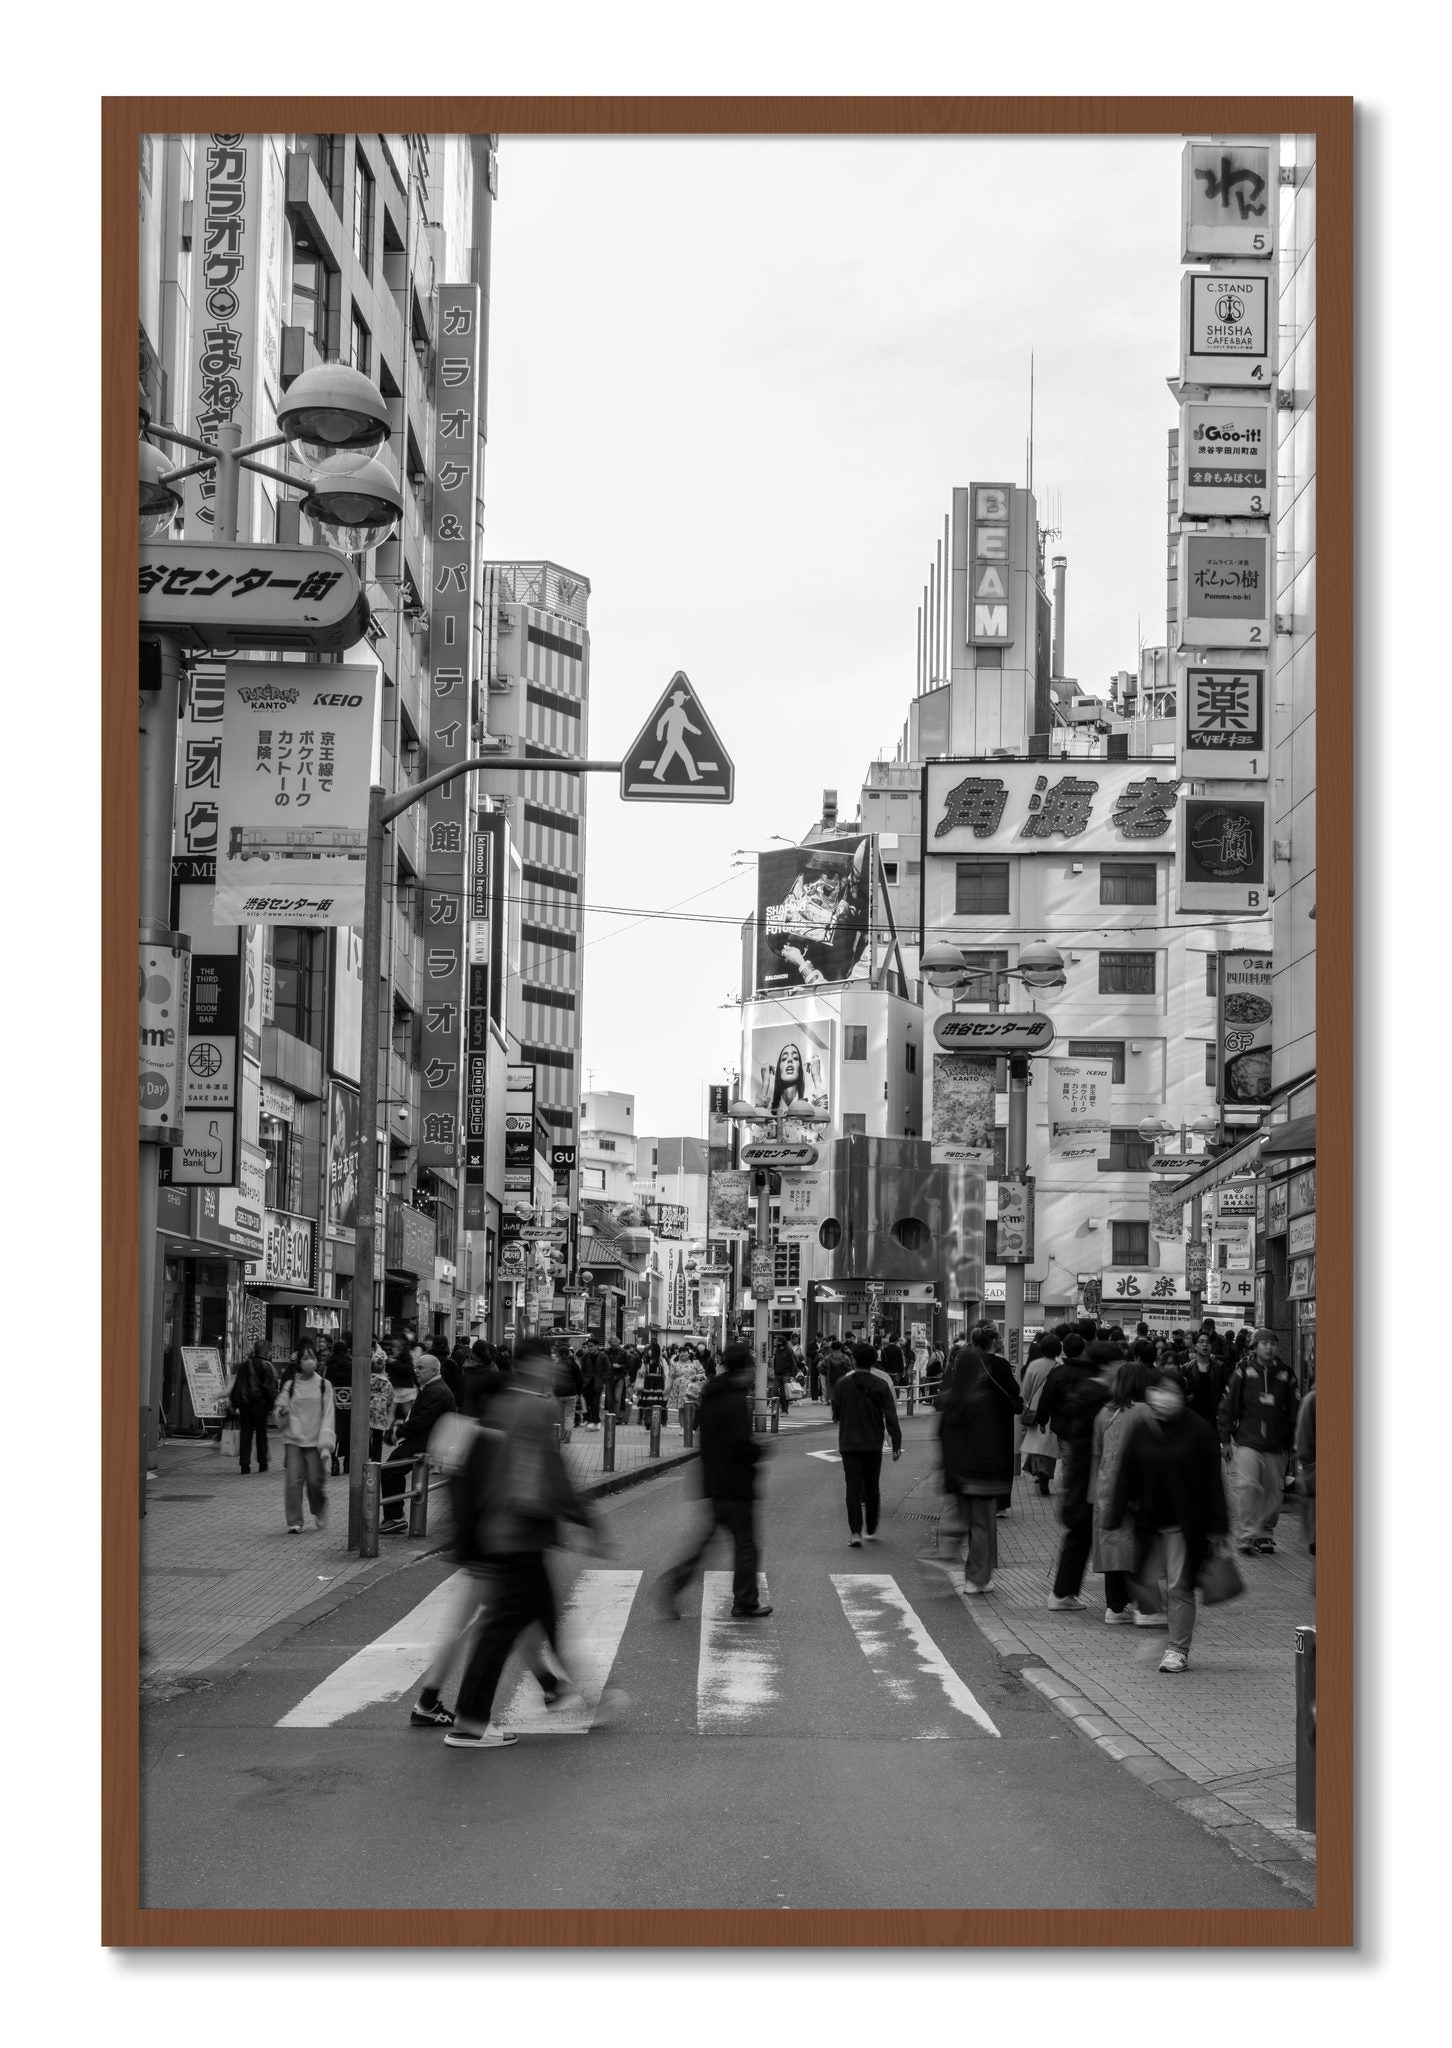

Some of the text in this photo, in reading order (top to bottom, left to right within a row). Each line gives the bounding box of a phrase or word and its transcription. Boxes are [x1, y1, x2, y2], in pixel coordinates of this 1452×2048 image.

[204, 146, 248, 290] カラオケ
[1252, 233, 1265, 250] 5
[1206, 283, 1253, 293] C.STAND
[1206, 325, 1253, 336] SHISHA
[1206, 336, 1253, 345] CAFE&BAR
[1251, 364, 1264, 381] 4
[1205, 425, 1262, 442] Goo-it!
[1198, 446, 1258, 455] 渋谷宇田川町店
[1193, 472, 1263, 484] 全身もみほぐし
[1249, 495, 1263, 513] 3
[974, 487, 1009, 637] BEAM
[1193, 568, 1260, 589] ポムの樹
[1249, 626, 1262, 643] 2
[251, 702, 287, 710] KANTO
[313, 693, 363, 708] KEIO
[1197, 676, 1250, 729] 薬
[256, 730, 273, 774] 冒険へ
[274, 730, 294, 807] カントーの
[295, 730, 315, 807] ポケパーク
[318, 732, 336, 793] 京王線で
[1248, 758, 1258, 775] 1
[934, 775, 1180, 839] 角海老
[1191, 816, 1254, 865] 一蘭
[476, 836, 486, 914] kimono hearts
[242, 897, 335, 912] 渋谷センター街
[1248, 890, 1260, 907] B
[200, 967, 215, 975] THE
[1226, 972, 1271, 985] 四川料理
[196, 975, 219, 983] THIRD
[195, 1004, 218, 1012] ROOM
[199, 1015, 214, 1023] BAR
[941, 1022, 1046, 1036] 渋谷センター街
[1225, 1031, 1254, 1052] 6F
[147, 1082, 167, 1097] Day!
[188, 1094, 230, 1102] SAKE BAR
[518, 1121, 531, 1130] UP
[183, 1148, 217, 1160] Whisky
[553, 1151, 575, 1163] GU
[744, 1149, 809, 1158] 渋谷センター街
[182, 1158, 204, 1167] Bank
[159, 1169, 170, 1180] 1F
[1116, 1274, 1177, 1297] 兆楽
[675, 1273, 685, 1317] BEER
